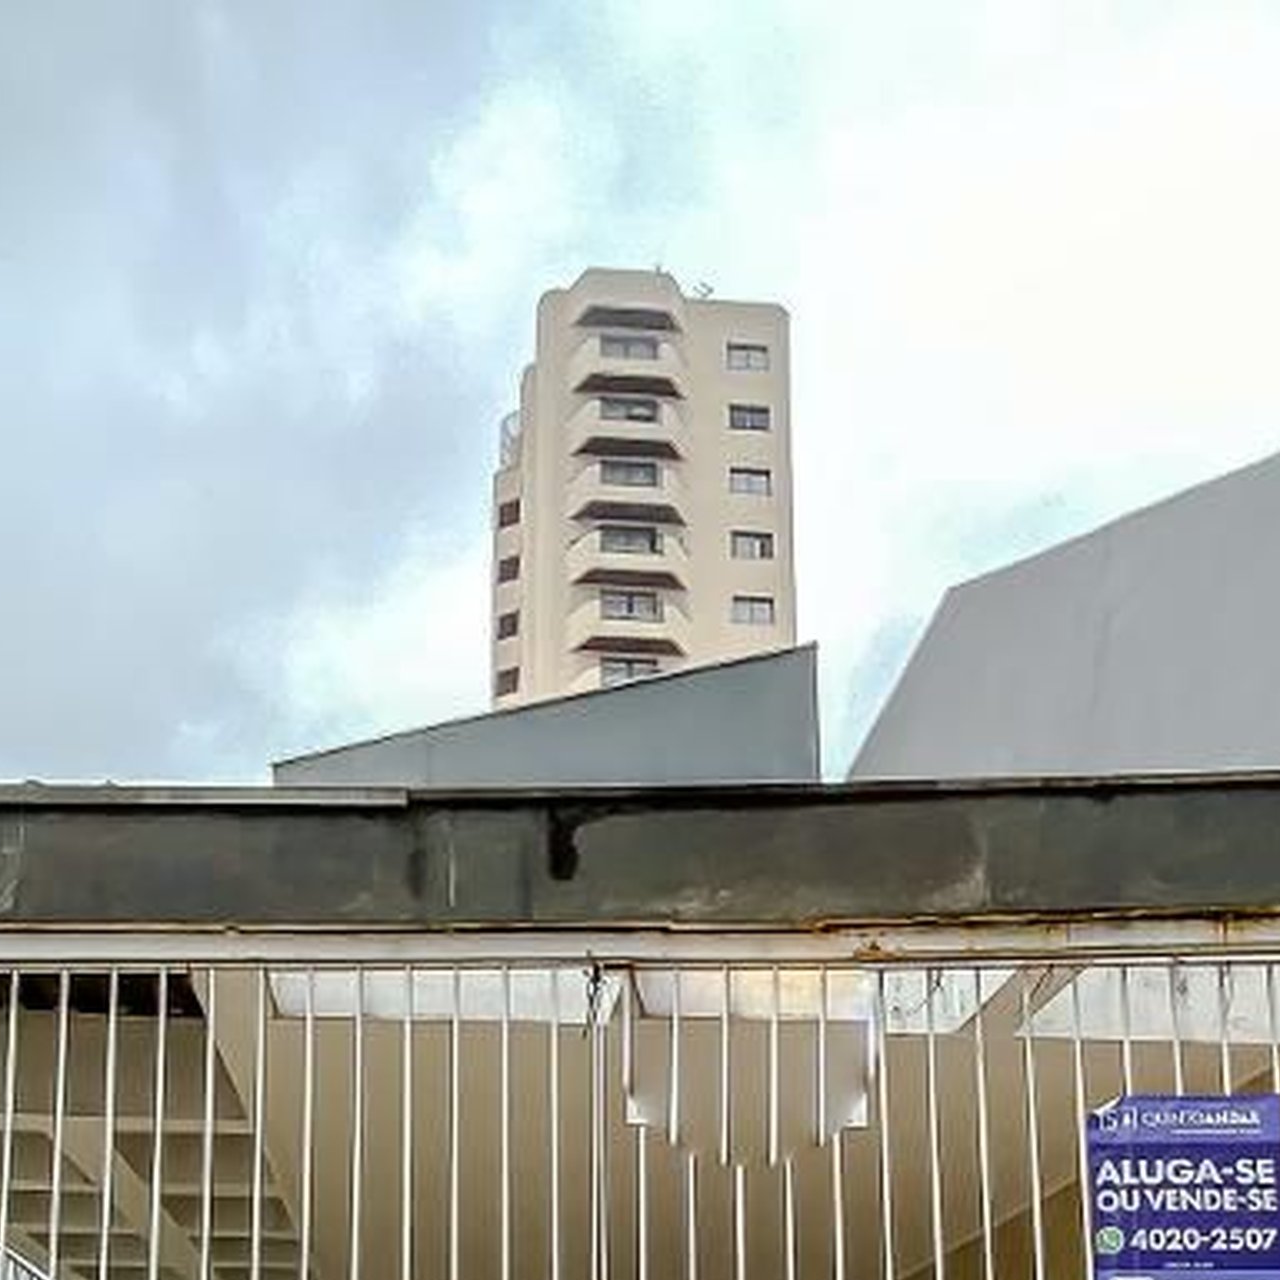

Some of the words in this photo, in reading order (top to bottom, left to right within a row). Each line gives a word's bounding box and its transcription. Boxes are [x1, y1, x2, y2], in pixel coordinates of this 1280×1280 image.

[1097, 1158, 1275, 1185] ALUGA-SE
[1097, 1191, 1140, 1211] OU
[1146, 1189, 1277, 1211] VENDE-SE
[1130, 1228, 1277, 1251] 4020-2507
